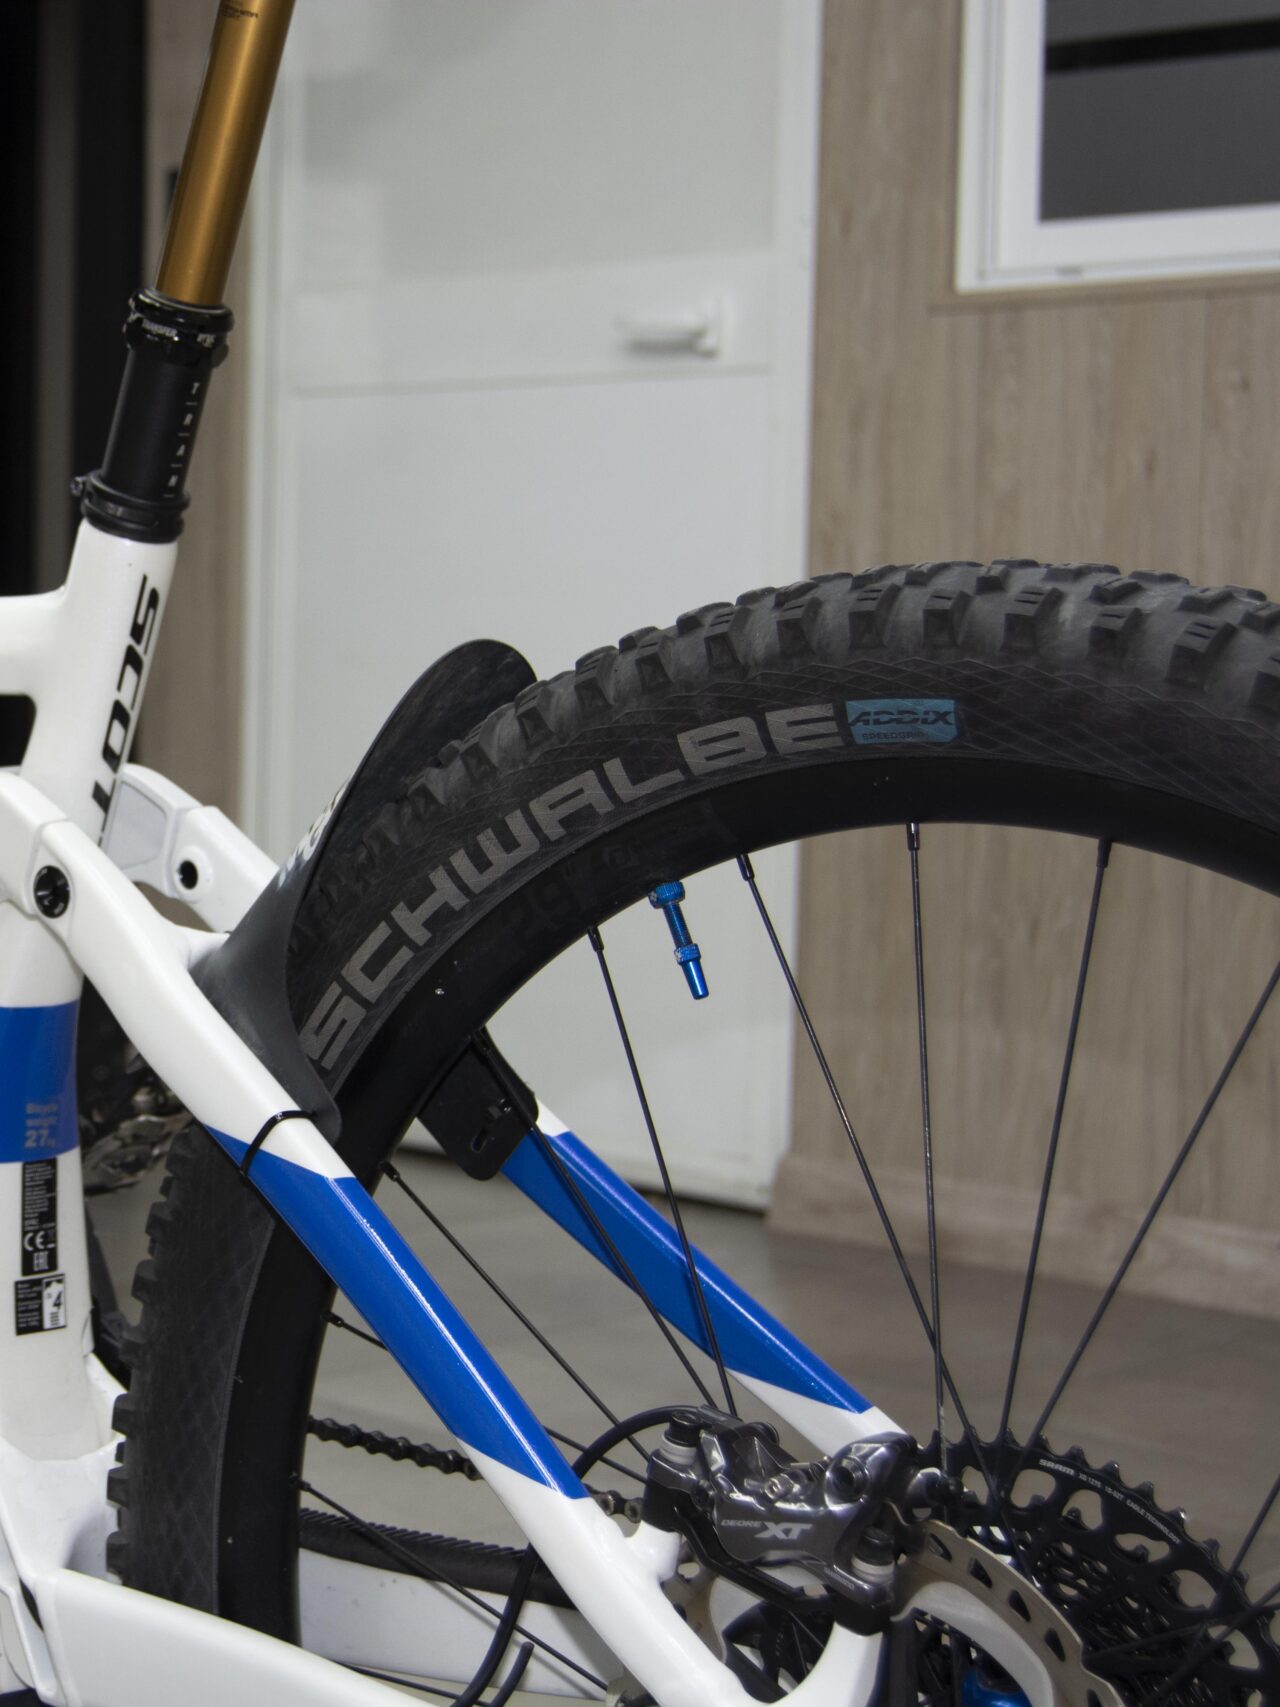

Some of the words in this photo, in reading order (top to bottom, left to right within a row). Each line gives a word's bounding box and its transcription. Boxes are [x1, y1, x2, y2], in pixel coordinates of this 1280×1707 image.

[91, 573, 160, 847] SCOT
[848, 709, 954, 726] ADDIX
[300, 703, 845, 1071] SCHWALBE
[1038, 1458, 1075, 1477] SRAM
[721, 1519, 762, 1529] DEORE
[754, 1520, 814, 1540] XT
